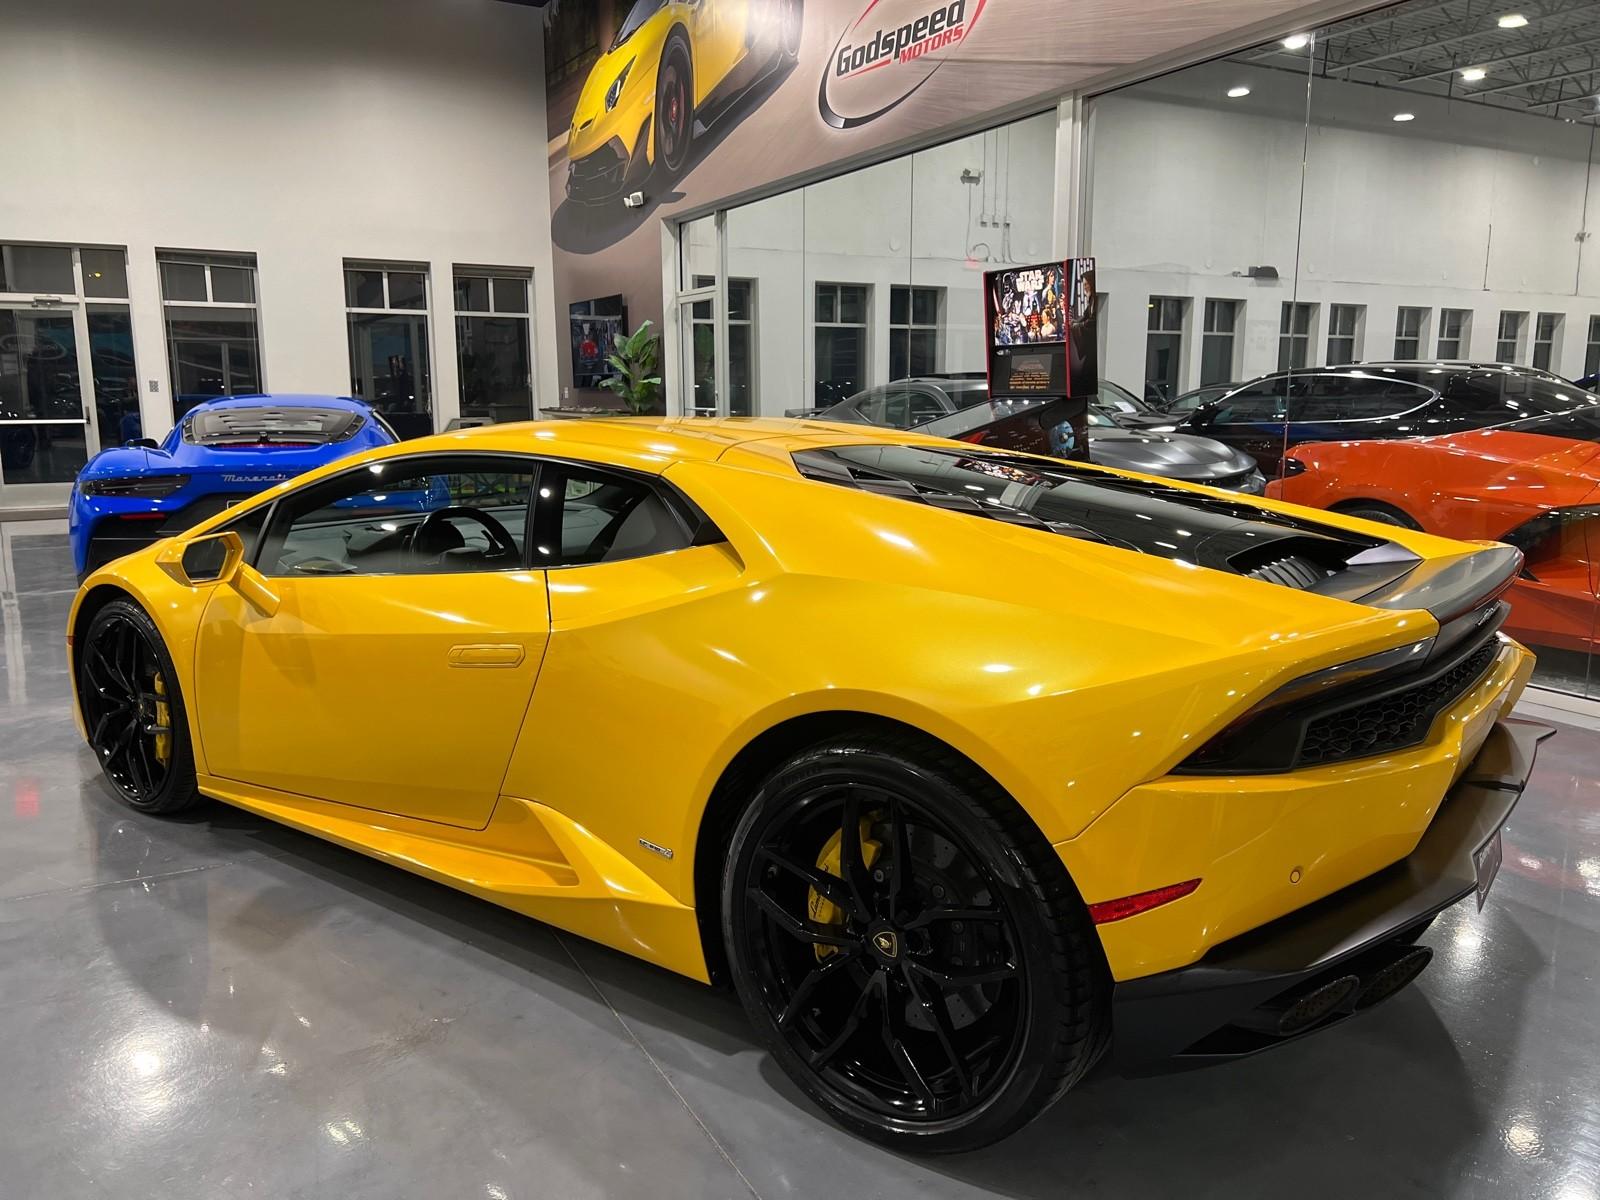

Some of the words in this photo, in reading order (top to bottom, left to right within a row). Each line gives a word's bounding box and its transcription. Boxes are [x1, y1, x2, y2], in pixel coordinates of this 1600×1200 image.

[836, 0, 966, 77] Godspeed
[899, 23, 965, 64] MOTORS
[1016, 277, 1045, 292] WARS
[1018, 269, 1045, 281] STAR
